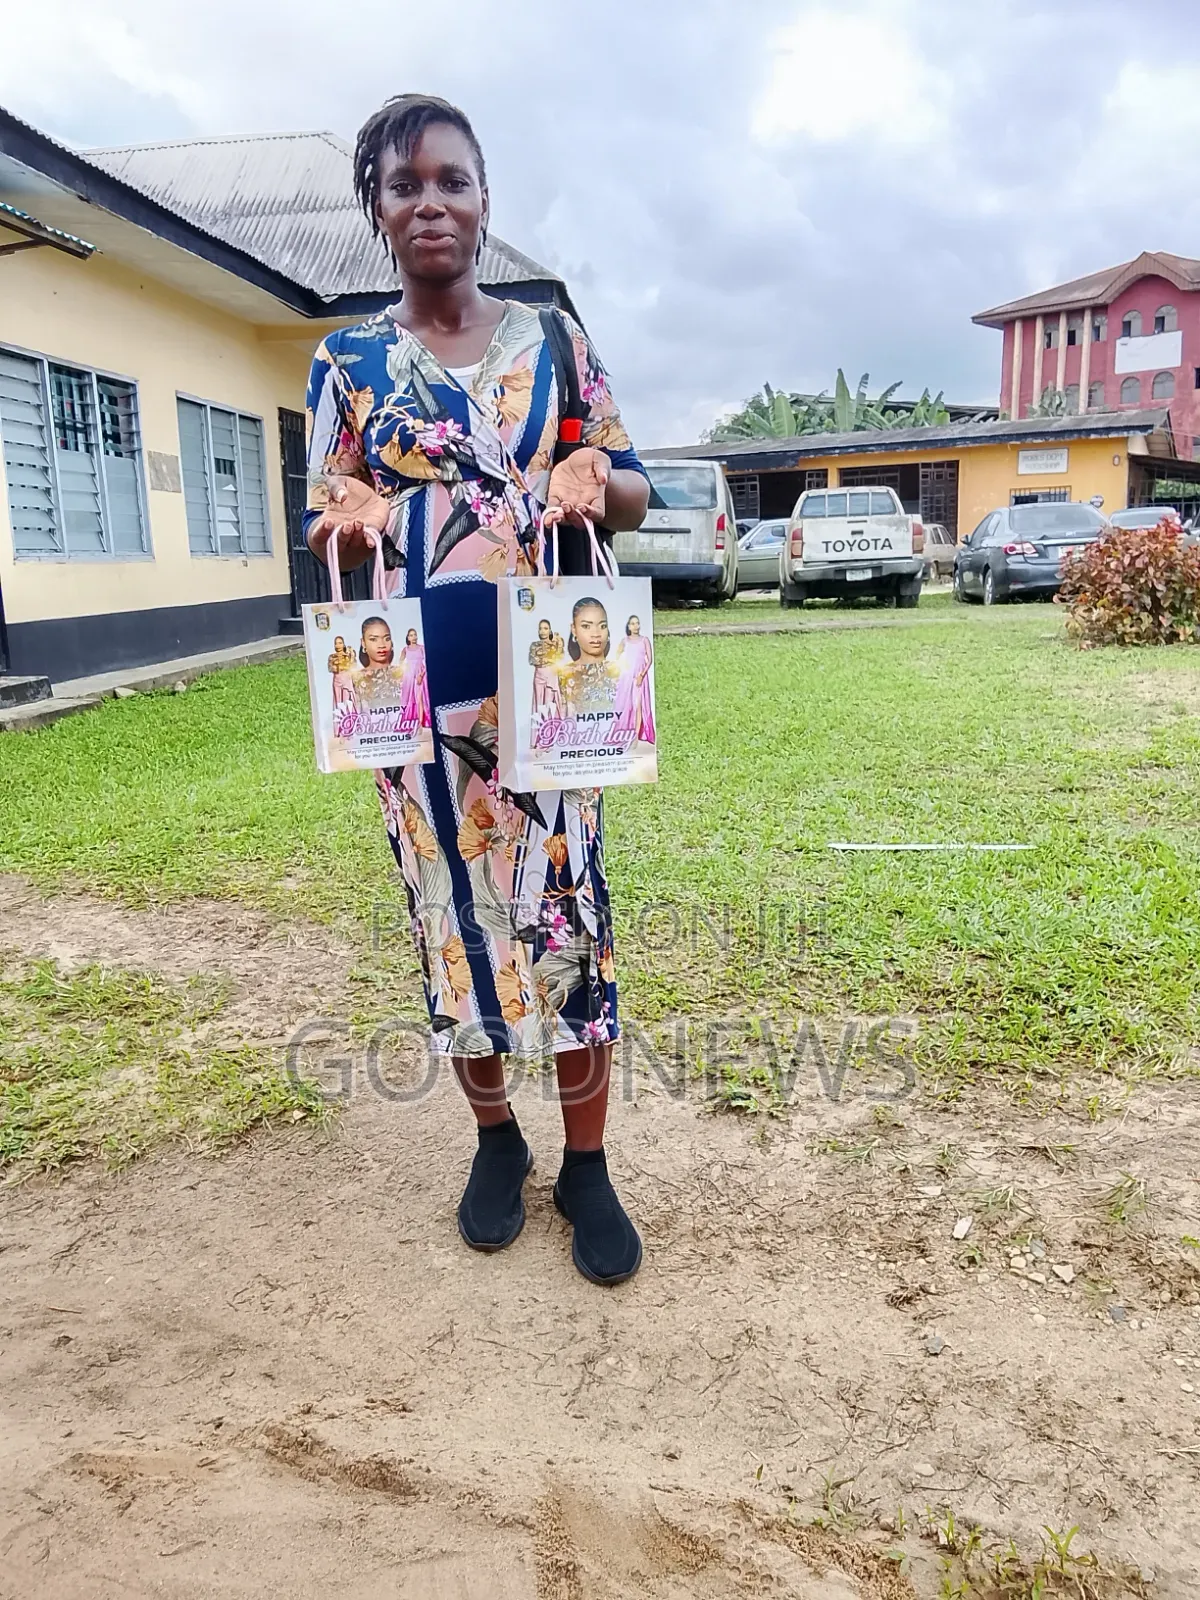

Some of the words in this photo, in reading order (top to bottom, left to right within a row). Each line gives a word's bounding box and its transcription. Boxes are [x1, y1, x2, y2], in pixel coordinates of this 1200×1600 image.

[822, 538, 893, 553] TOYOTA
[369, 706, 407, 715] HAPPY
[576, 712, 623, 722] HAPPY
[340, 713, 420, 738] Birthday
[360, 734, 412, 745] PRECIOUS
[538, 718, 637, 753] Birthday
[560, 748, 624, 759] PRECIOUS
